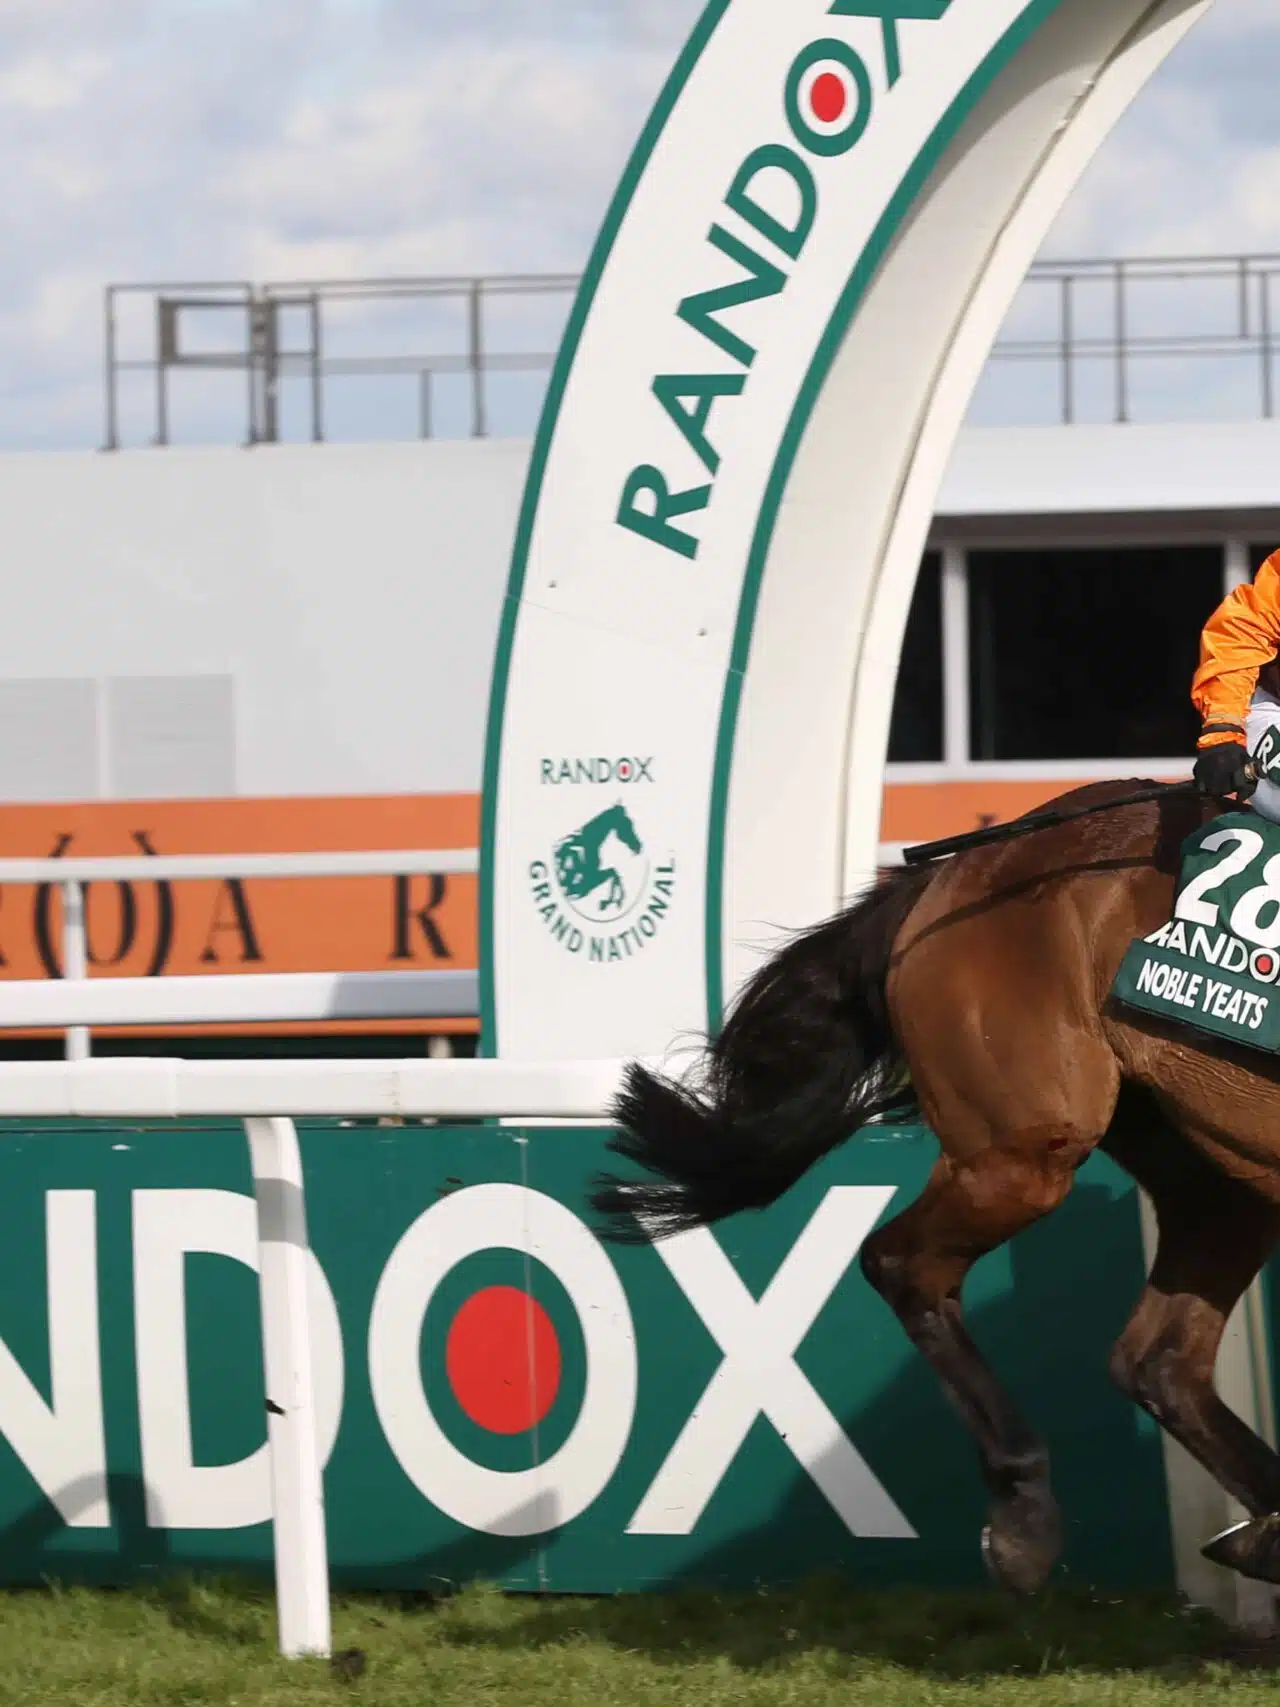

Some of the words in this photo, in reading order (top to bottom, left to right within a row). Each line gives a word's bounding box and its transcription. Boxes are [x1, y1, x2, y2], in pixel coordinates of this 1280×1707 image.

[615, 0, 954, 560] RANDOX
[540, 756, 655, 784] RANDOX
[529, 860, 584, 953] GRAND
[588, 857, 676, 963] NATIONAL
[1136, 958, 1204, 1009] NOBLE
[1201, 978, 1269, 1030] YEATS
